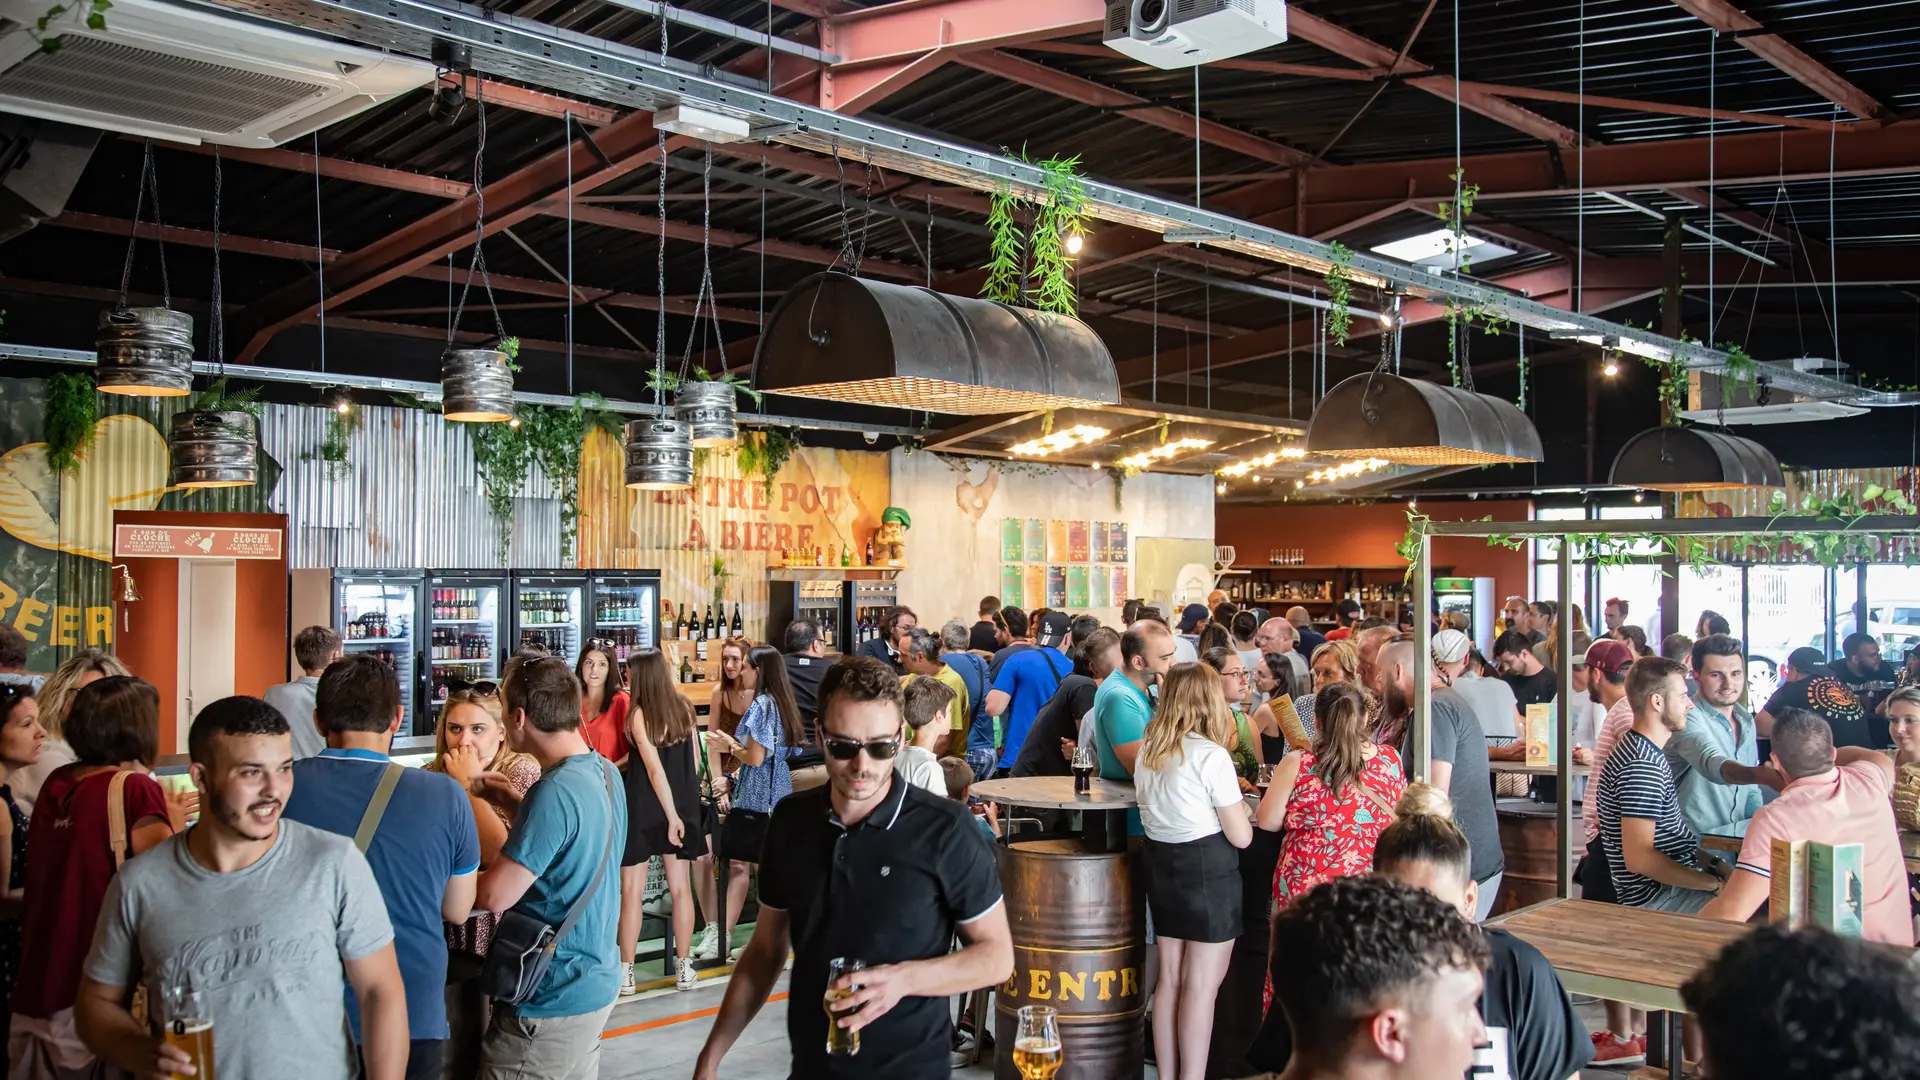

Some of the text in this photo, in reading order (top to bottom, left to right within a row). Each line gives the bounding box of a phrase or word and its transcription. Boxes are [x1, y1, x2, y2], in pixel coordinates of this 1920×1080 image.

[646, 451, 681, 465] POT
[780, 483, 841, 514] POT
[130, 534, 171, 542] CLOCHE
